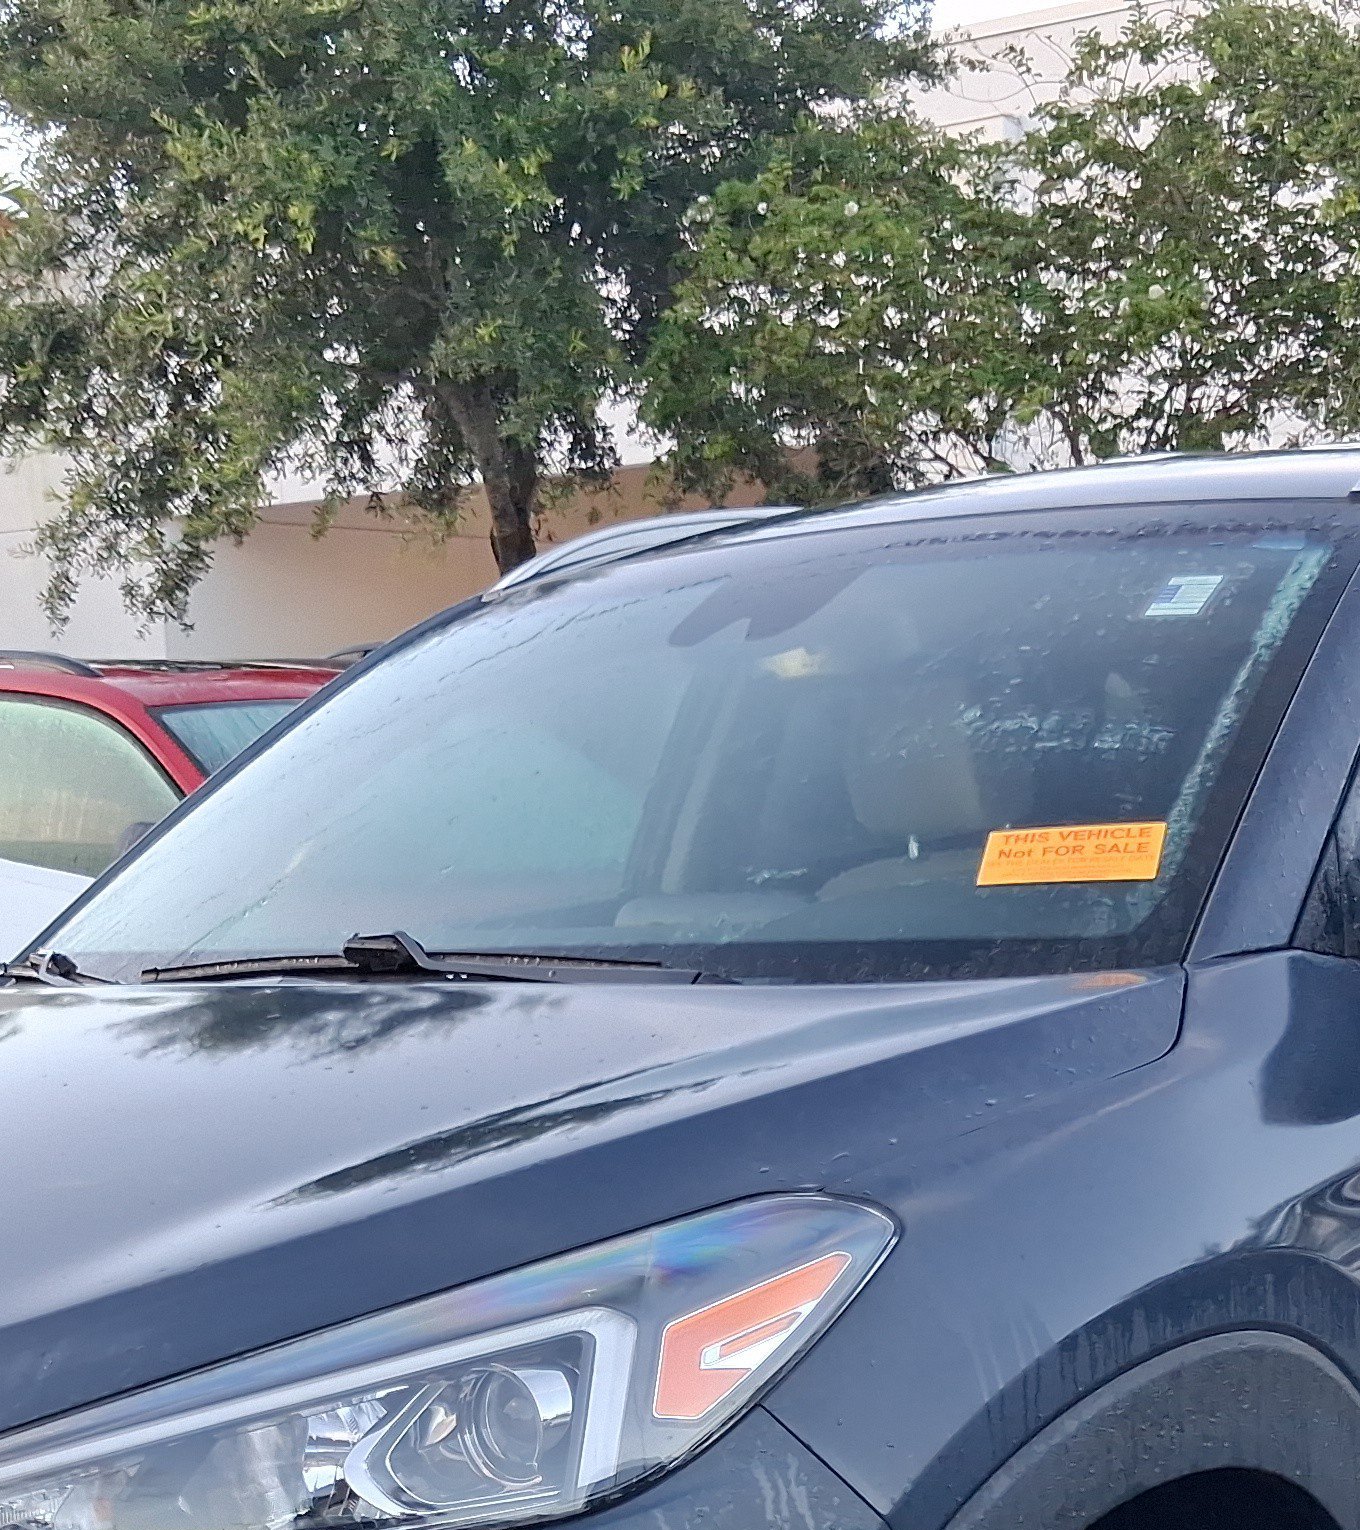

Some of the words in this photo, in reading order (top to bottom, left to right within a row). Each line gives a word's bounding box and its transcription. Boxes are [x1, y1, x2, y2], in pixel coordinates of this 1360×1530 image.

[1003, 831, 1051, 846] THIS
[1059, 826, 1153, 842] VEHICLE
[998, 848, 1033, 860] Not
[1042, 845, 1085, 857] FOR
[1095, 841, 1151, 855] SALE
